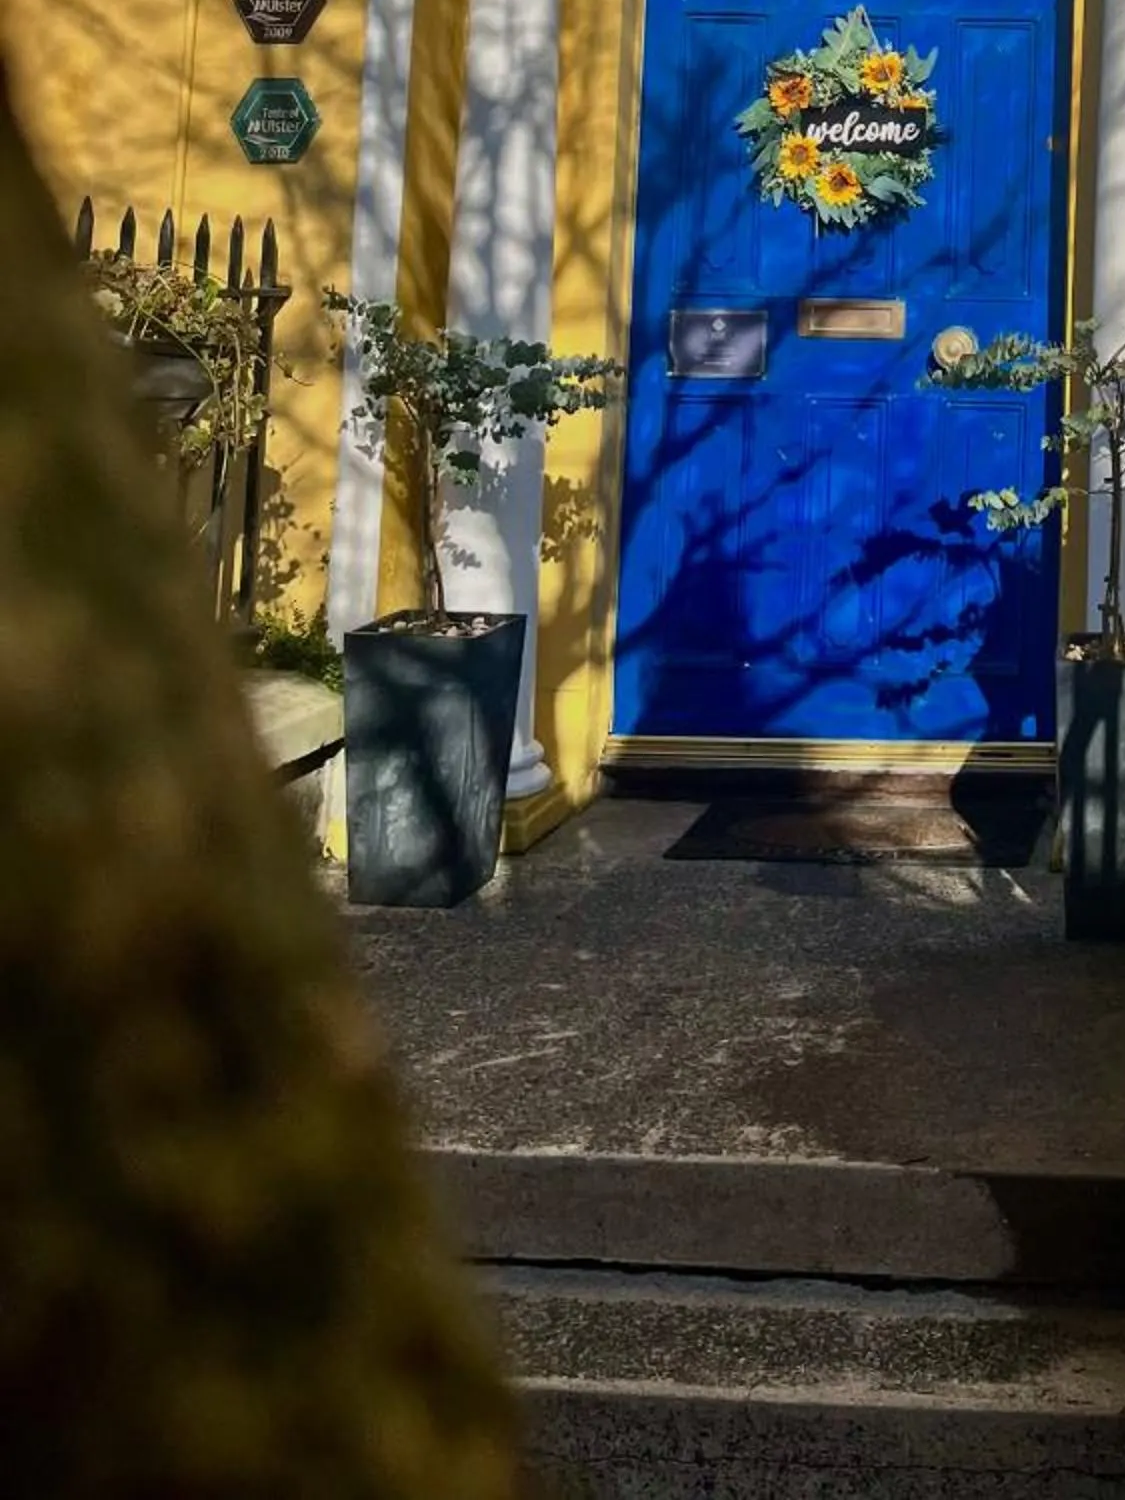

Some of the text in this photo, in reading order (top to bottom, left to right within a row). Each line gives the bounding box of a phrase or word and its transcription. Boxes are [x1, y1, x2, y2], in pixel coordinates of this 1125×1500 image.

[266, 0, 303, 12] Ulster
[263, 27, 293, 38] 2009
[263, 107, 288, 118] Taste
[261, 119, 301, 133] Ulster
[806, 111, 920, 145] welcome
